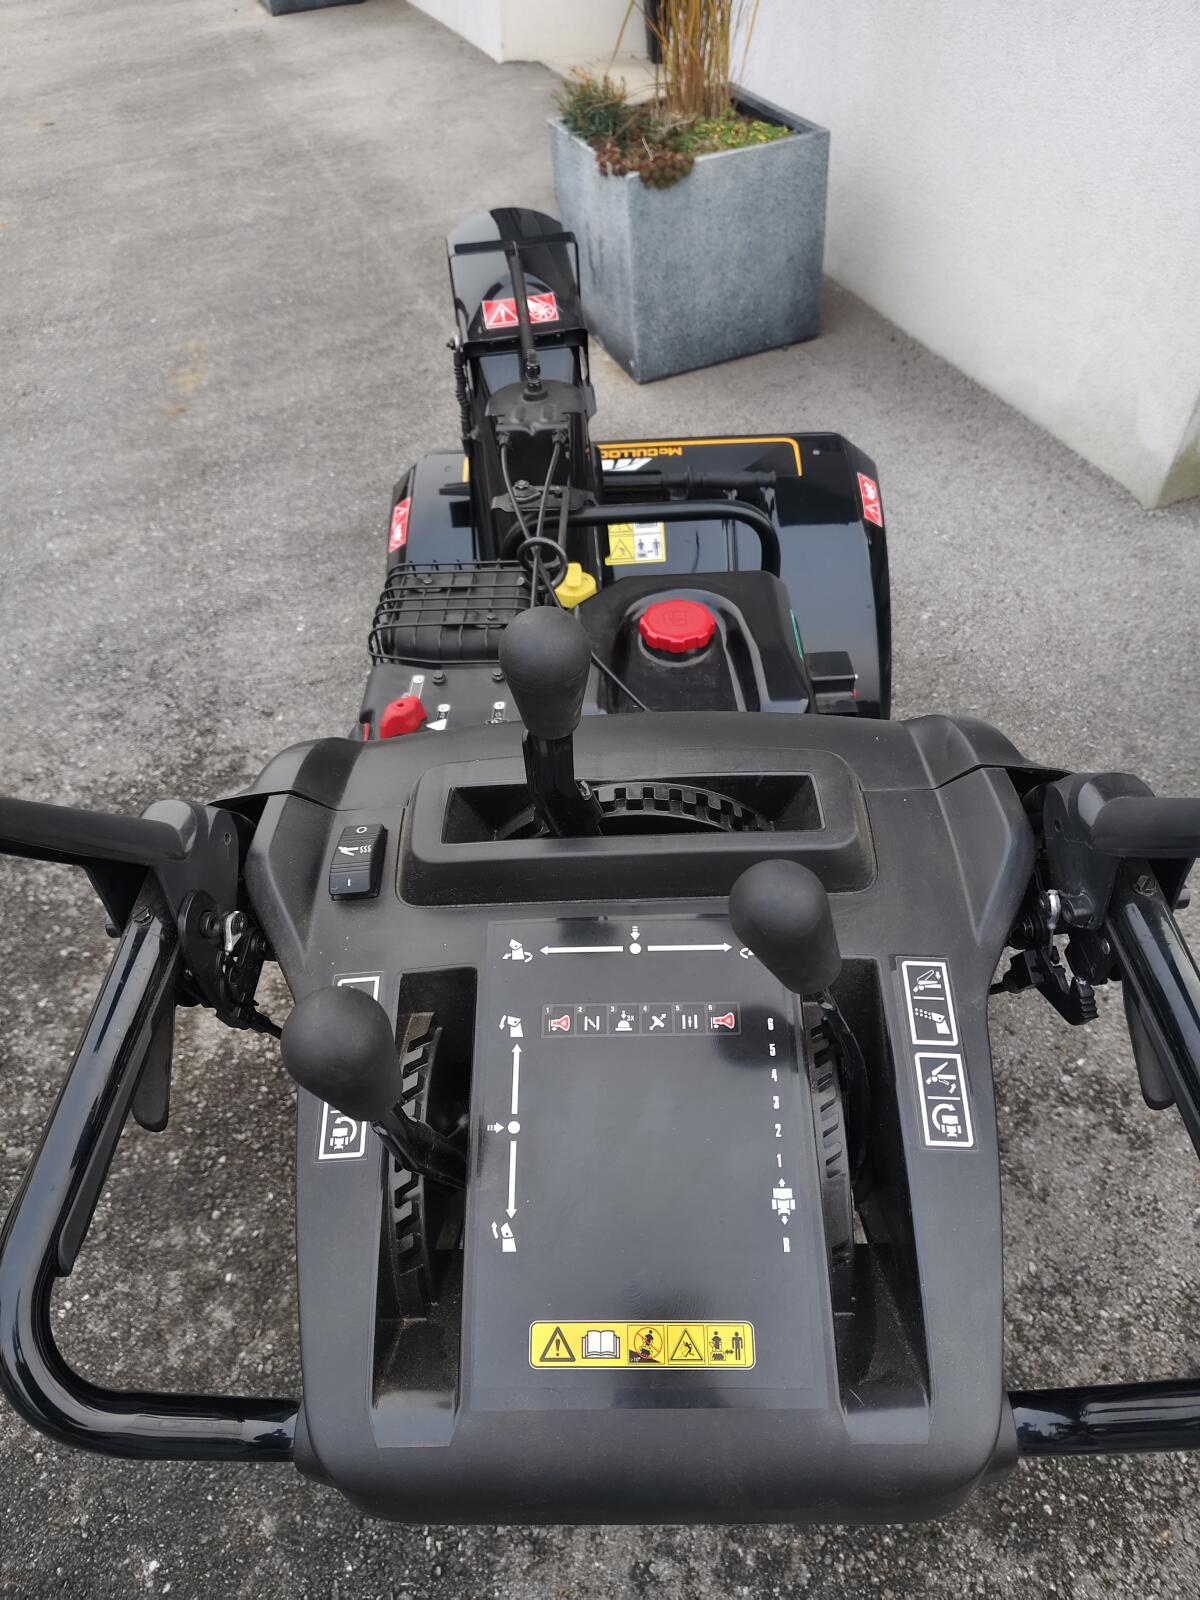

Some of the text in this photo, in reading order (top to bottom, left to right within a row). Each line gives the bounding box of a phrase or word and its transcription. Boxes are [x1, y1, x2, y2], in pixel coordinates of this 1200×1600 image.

[600, 447, 683, 459] McCULLOC
[767, 1017, 774, 1031] 6
[769, 1043, 776, 1057] 5
[771, 1068, 778, 1082] 4
[772, 1095, 780, 1109] 3
[774, 1123, 782, 1138] 2
[776, 1153, 782, 1167] 1
